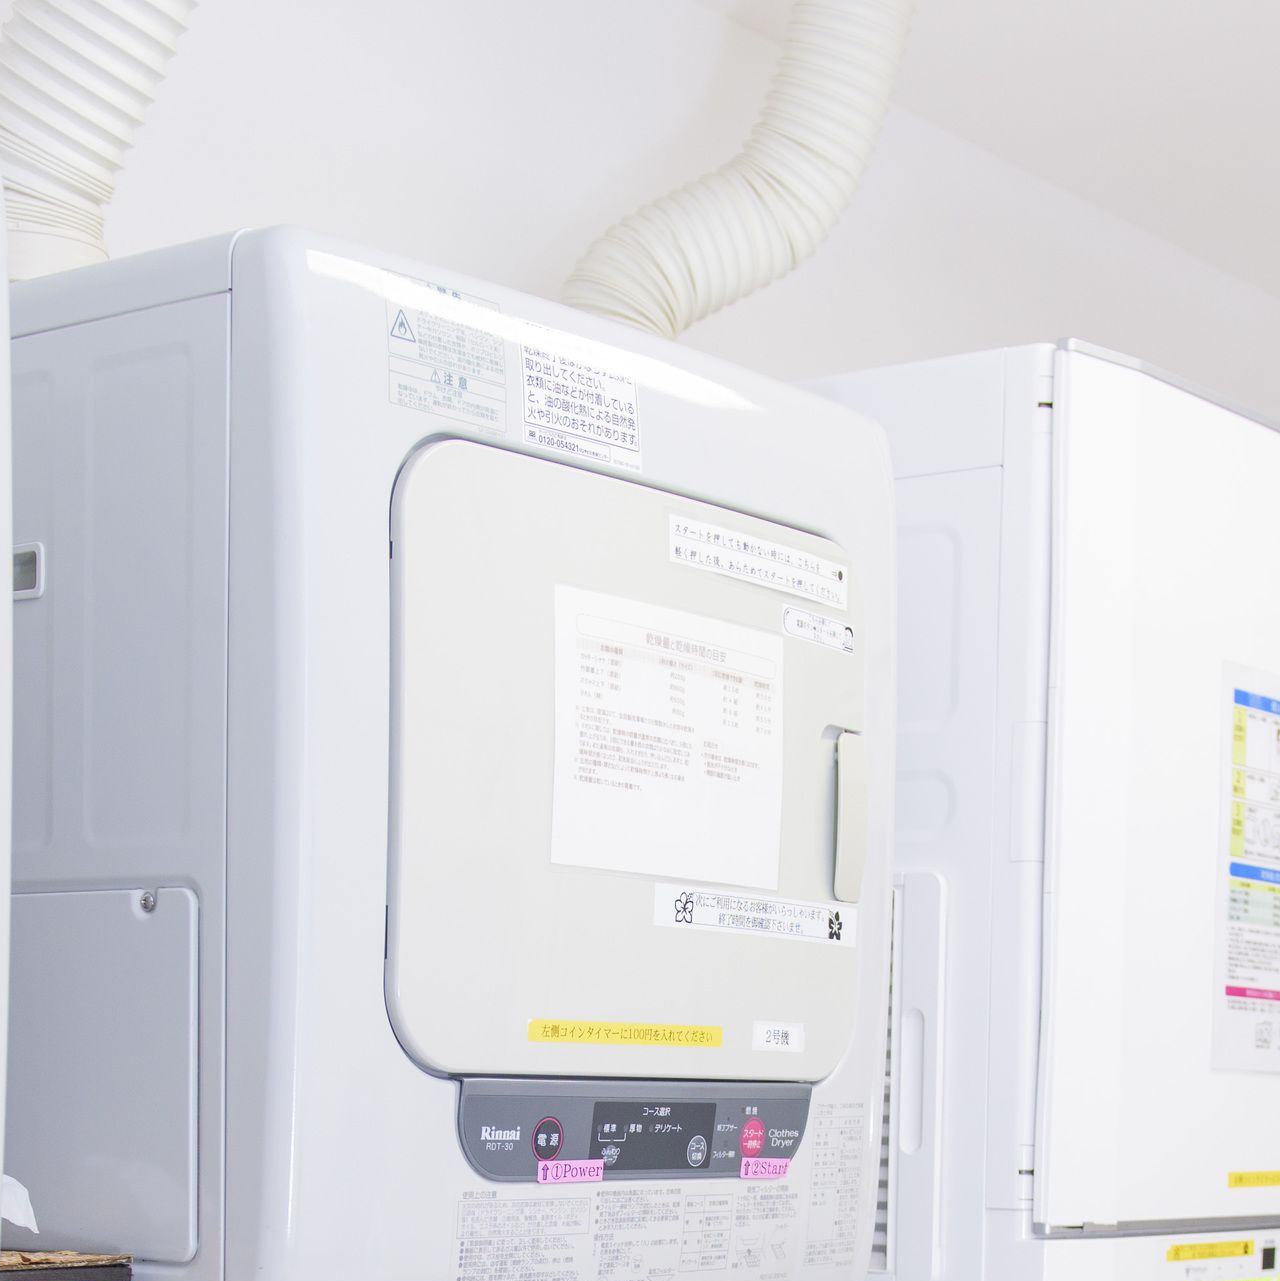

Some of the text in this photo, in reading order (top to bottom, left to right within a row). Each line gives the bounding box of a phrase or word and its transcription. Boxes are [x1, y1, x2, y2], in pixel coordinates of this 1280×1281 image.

[525, 357, 606, 391] 取り出してください。
[526, 374, 634, 415] 衣類に油などが付着している
[527, 390, 636, 431] と、油の酸化熱による自然発
[527, 406, 638, 446] 火や引火のおそれがあります。
[538, 434, 579, 453] 0120-054321
[674, 523, 821, 573] スタートを押しても動かない時には、こちらを
[695, 894, 825, 922] 次にご利用になるお客様がいらっしゃいます。
[718, 912, 804, 934] 終了時間を御確認下さいませ。
[541, 1024, 713, 1044] 左側コインタイマーに100円を入れてください
[765, 1029, 790, 1046] 2号機
[642, 1106, 671, 1118] コース選択
[480, 1126, 521, 1141] Rinnai
[654, 1123, 683, 1134] デリケート
[742, 1129, 764, 1138] スタート
[768, 1128, 799, 1138] Clothes
[486, 1142, 514, 1152] RDT-30
[537, 1133, 560, 1148] 電源
[690, 1141, 706, 1151] コース
[771, 1138, 794, 1148] Dryer
[551, 1162, 603, 1181] ①Power
